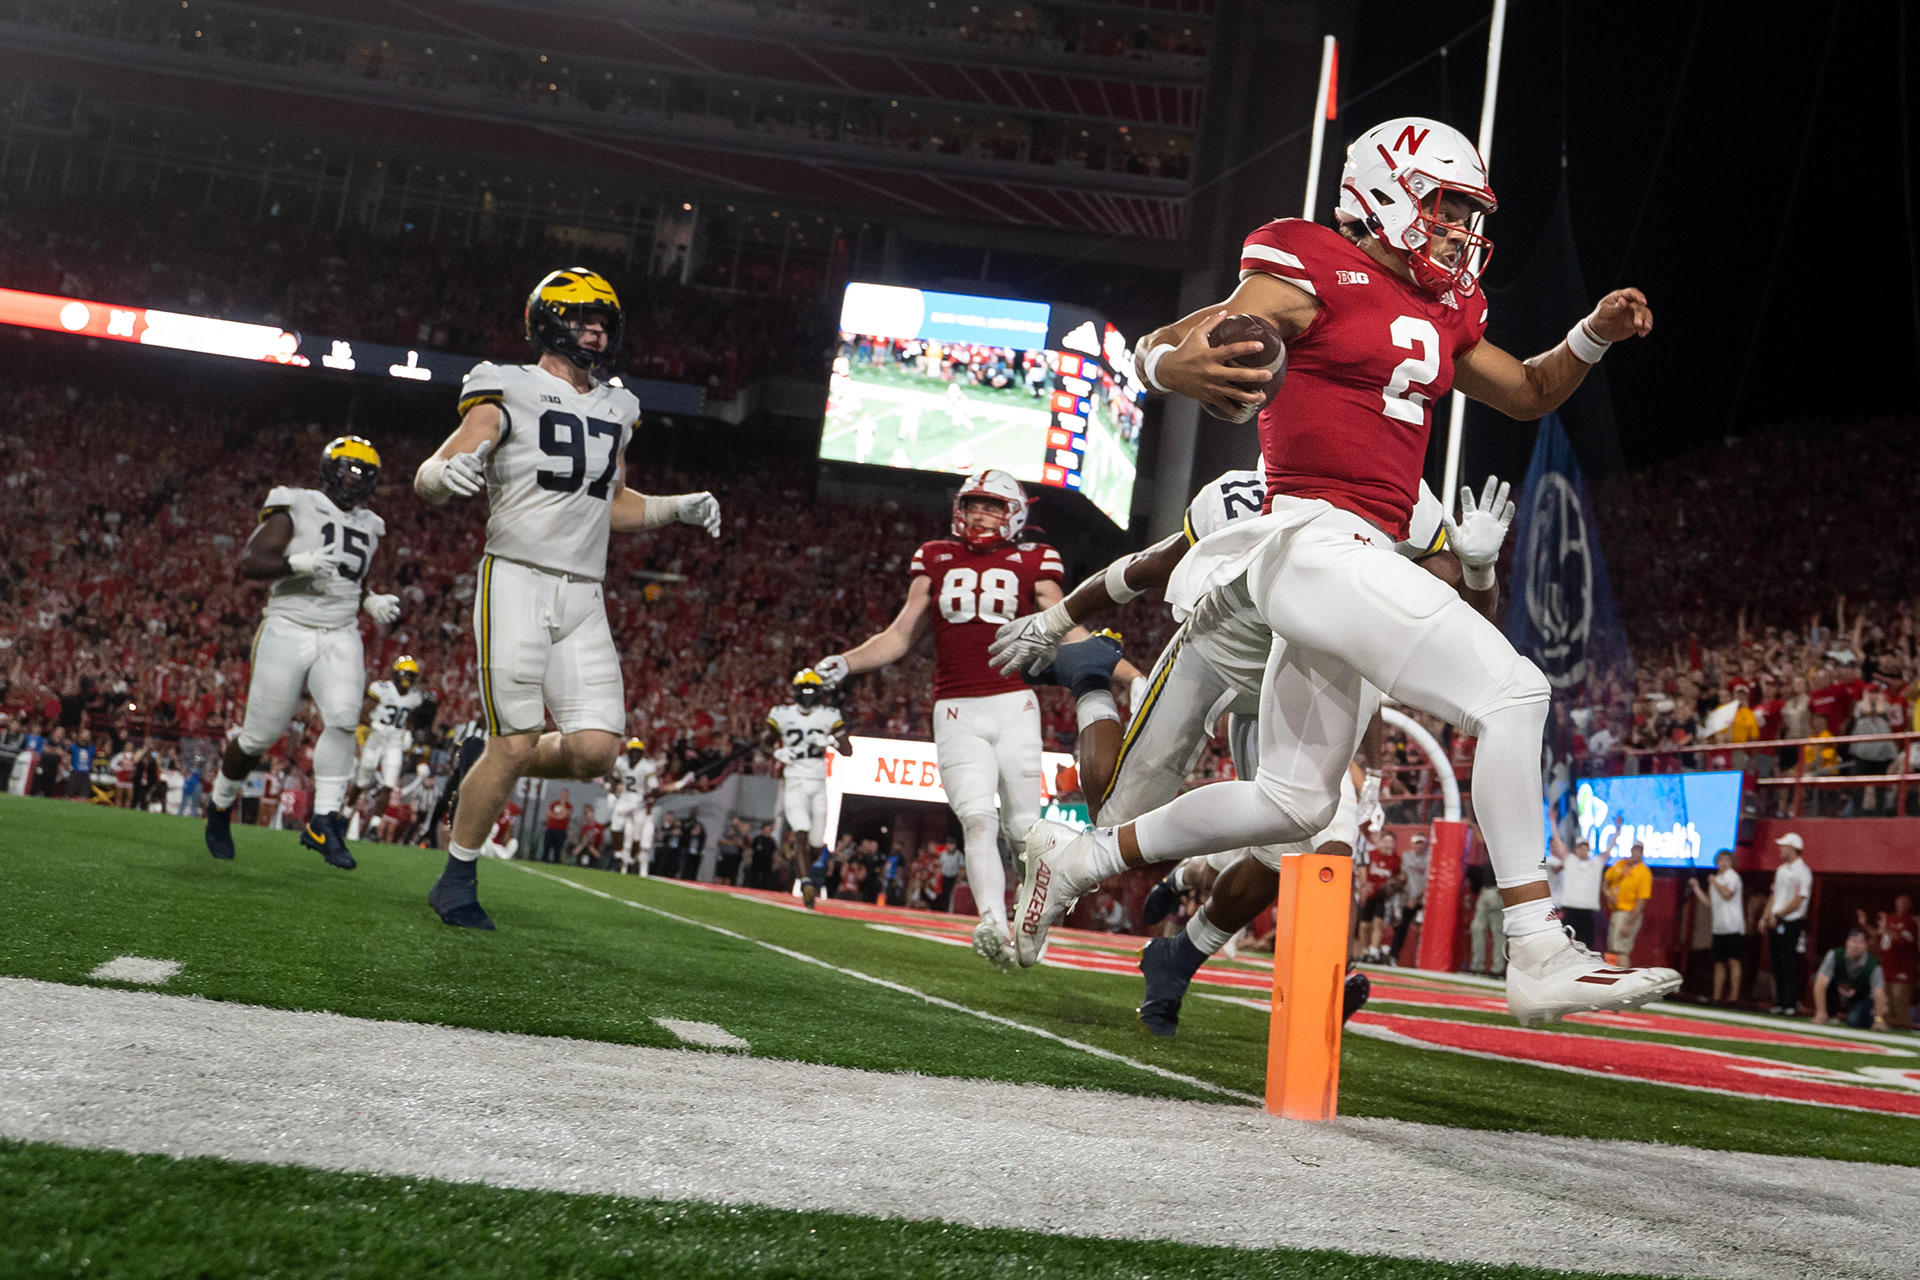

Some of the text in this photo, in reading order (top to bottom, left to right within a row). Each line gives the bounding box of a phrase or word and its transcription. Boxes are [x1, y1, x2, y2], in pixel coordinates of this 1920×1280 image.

[1393, 125, 1430, 156] N
[1382, 315, 1440, 426] 2
[537, 409, 623, 501] 97
[321, 521, 371, 584] 15
[938, 567, 1020, 625] 88
[946, 706, 959, 721] N
[874, 756, 944, 790] NEB
